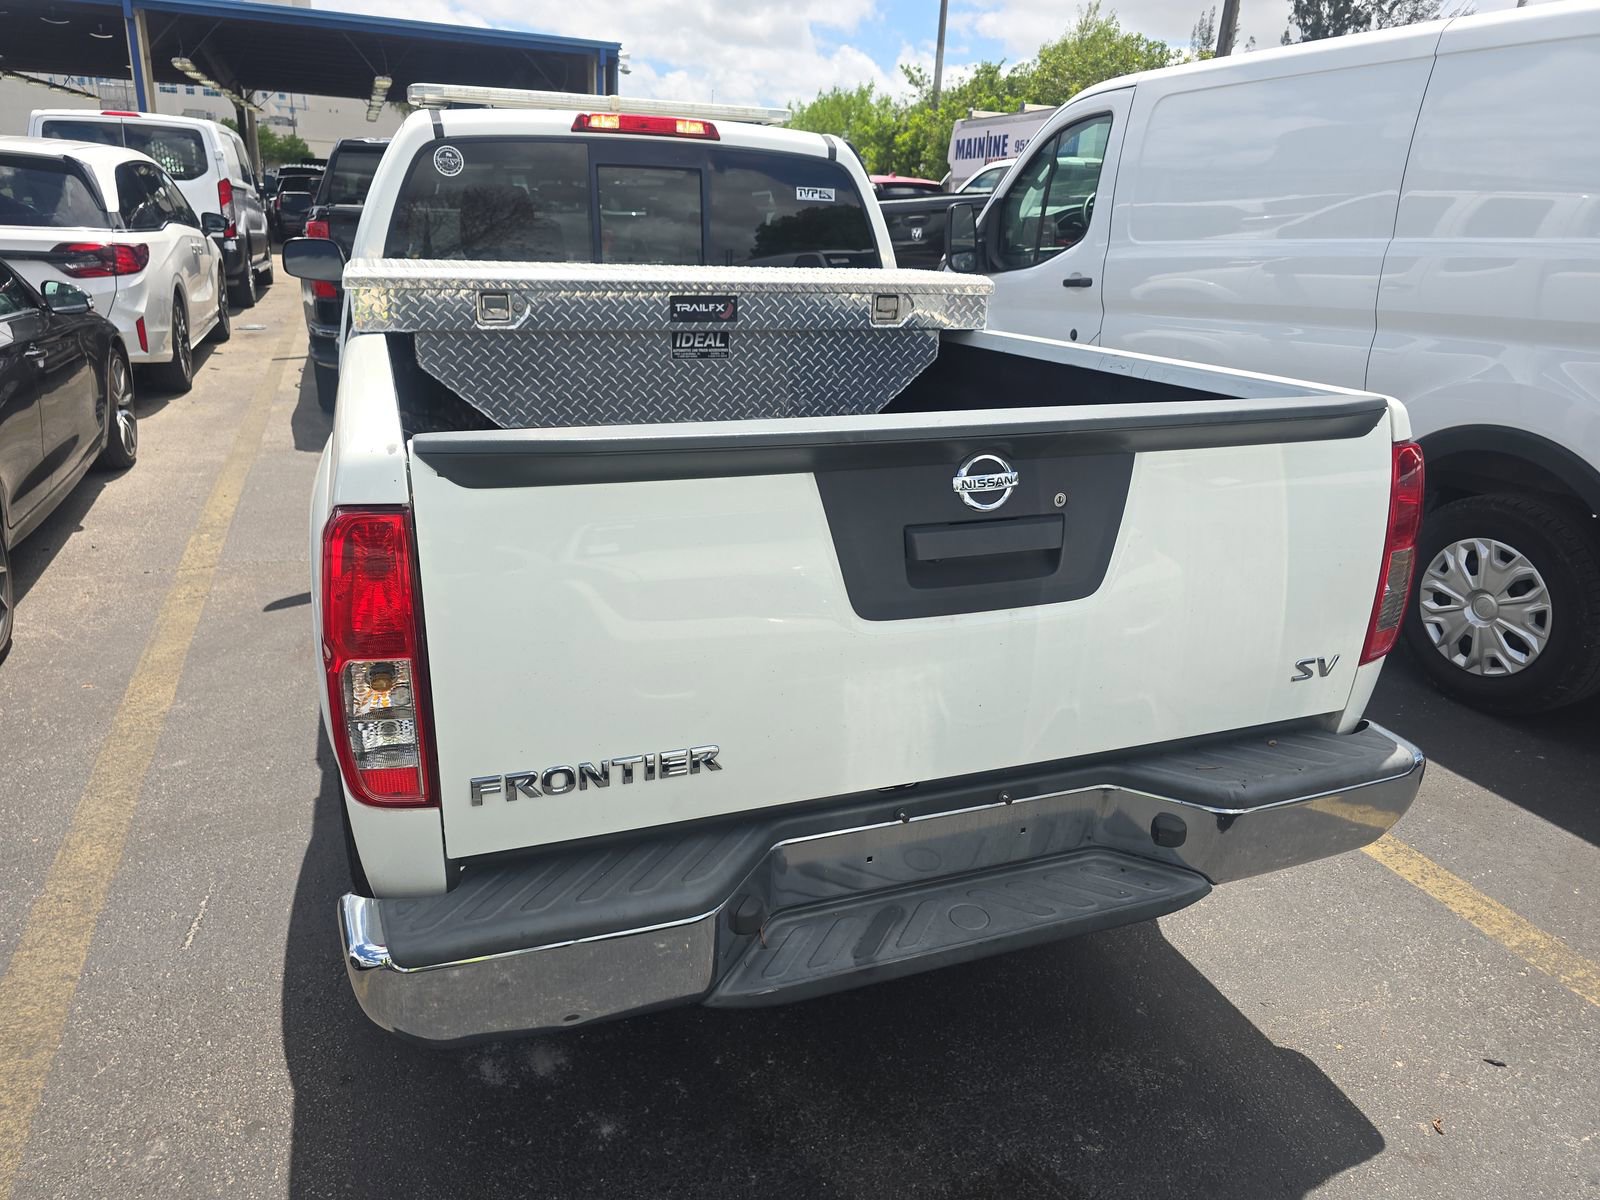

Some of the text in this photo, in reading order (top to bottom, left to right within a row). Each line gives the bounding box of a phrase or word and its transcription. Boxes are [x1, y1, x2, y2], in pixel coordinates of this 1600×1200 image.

[955, 134, 1009, 160] MAININE
[675, 303, 725, 312] TRAILFX
[676, 332, 725, 347] IDEAL
[961, 475, 1013, 489] NISSAN
[1290, 654, 1340, 682] SV
[470, 744, 722, 806] FRONTIER
